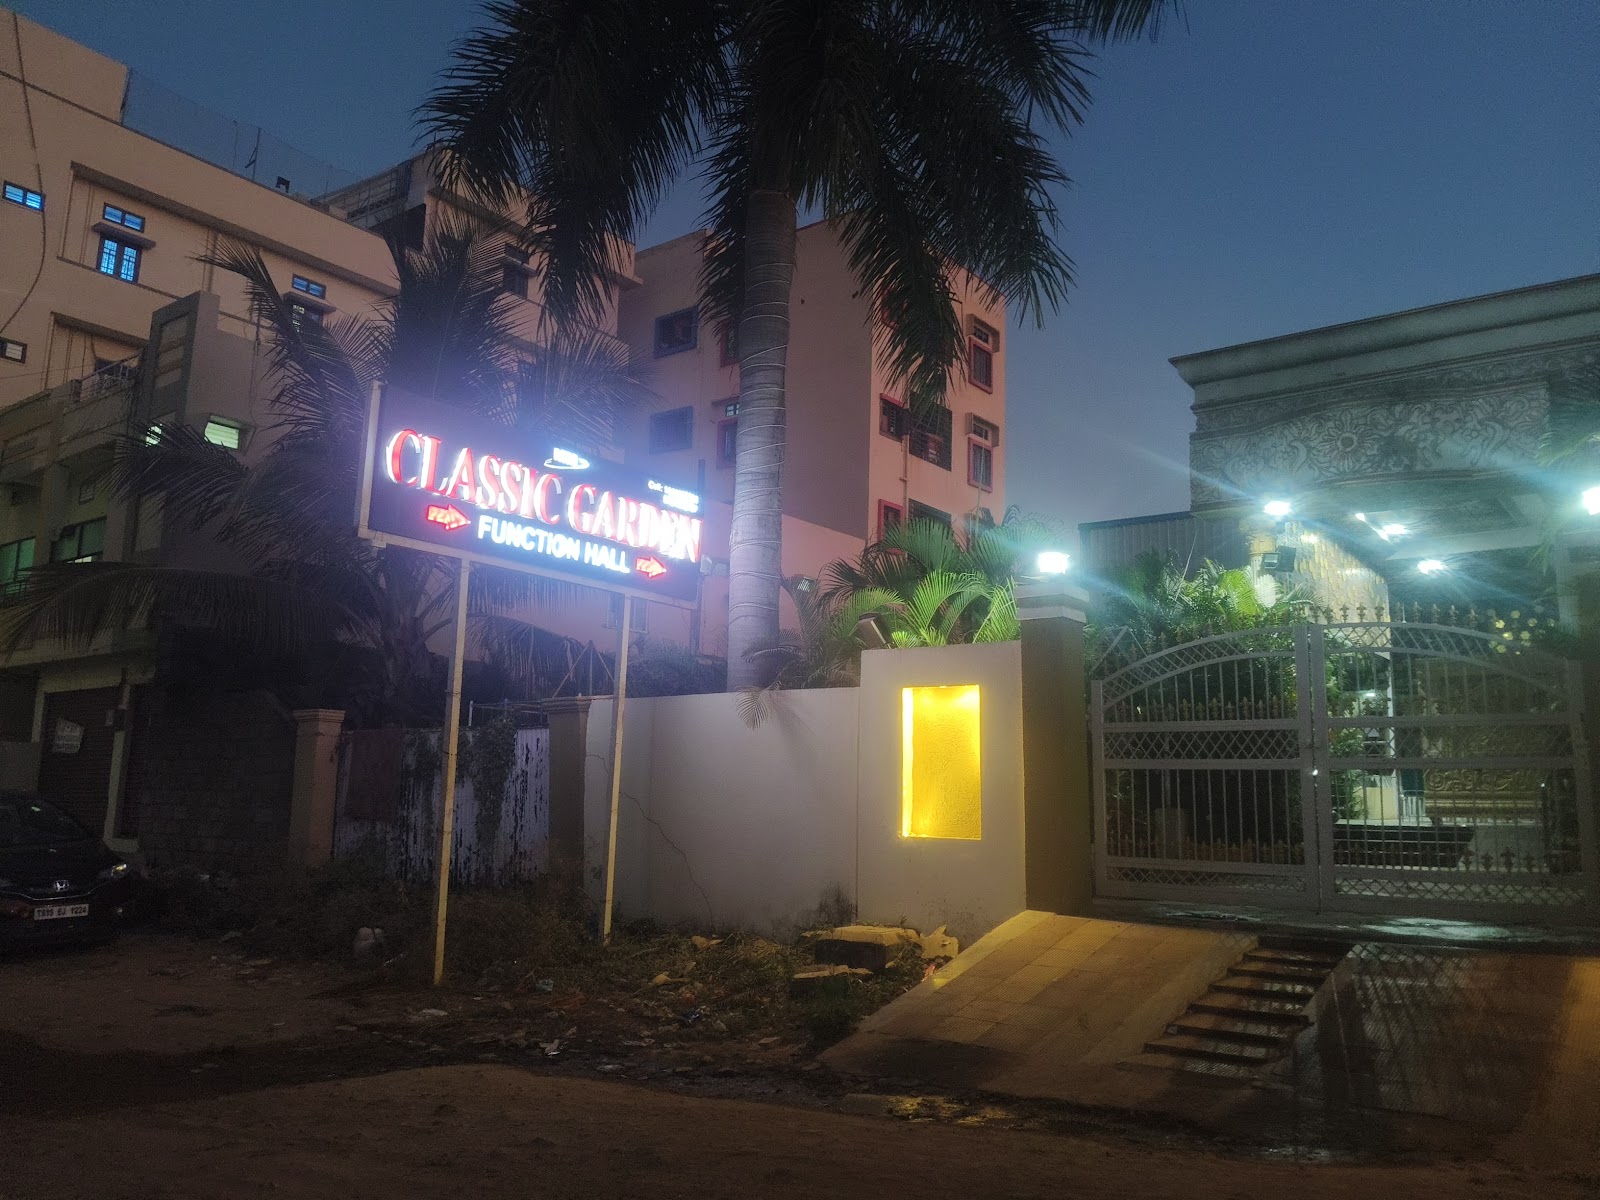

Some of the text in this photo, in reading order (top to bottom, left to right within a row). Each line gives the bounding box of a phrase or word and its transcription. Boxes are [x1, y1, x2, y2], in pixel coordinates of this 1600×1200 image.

[386, 428, 702, 563] CLASSIC GARDEN
[477, 514, 631, 574] FUNCTION HALL
